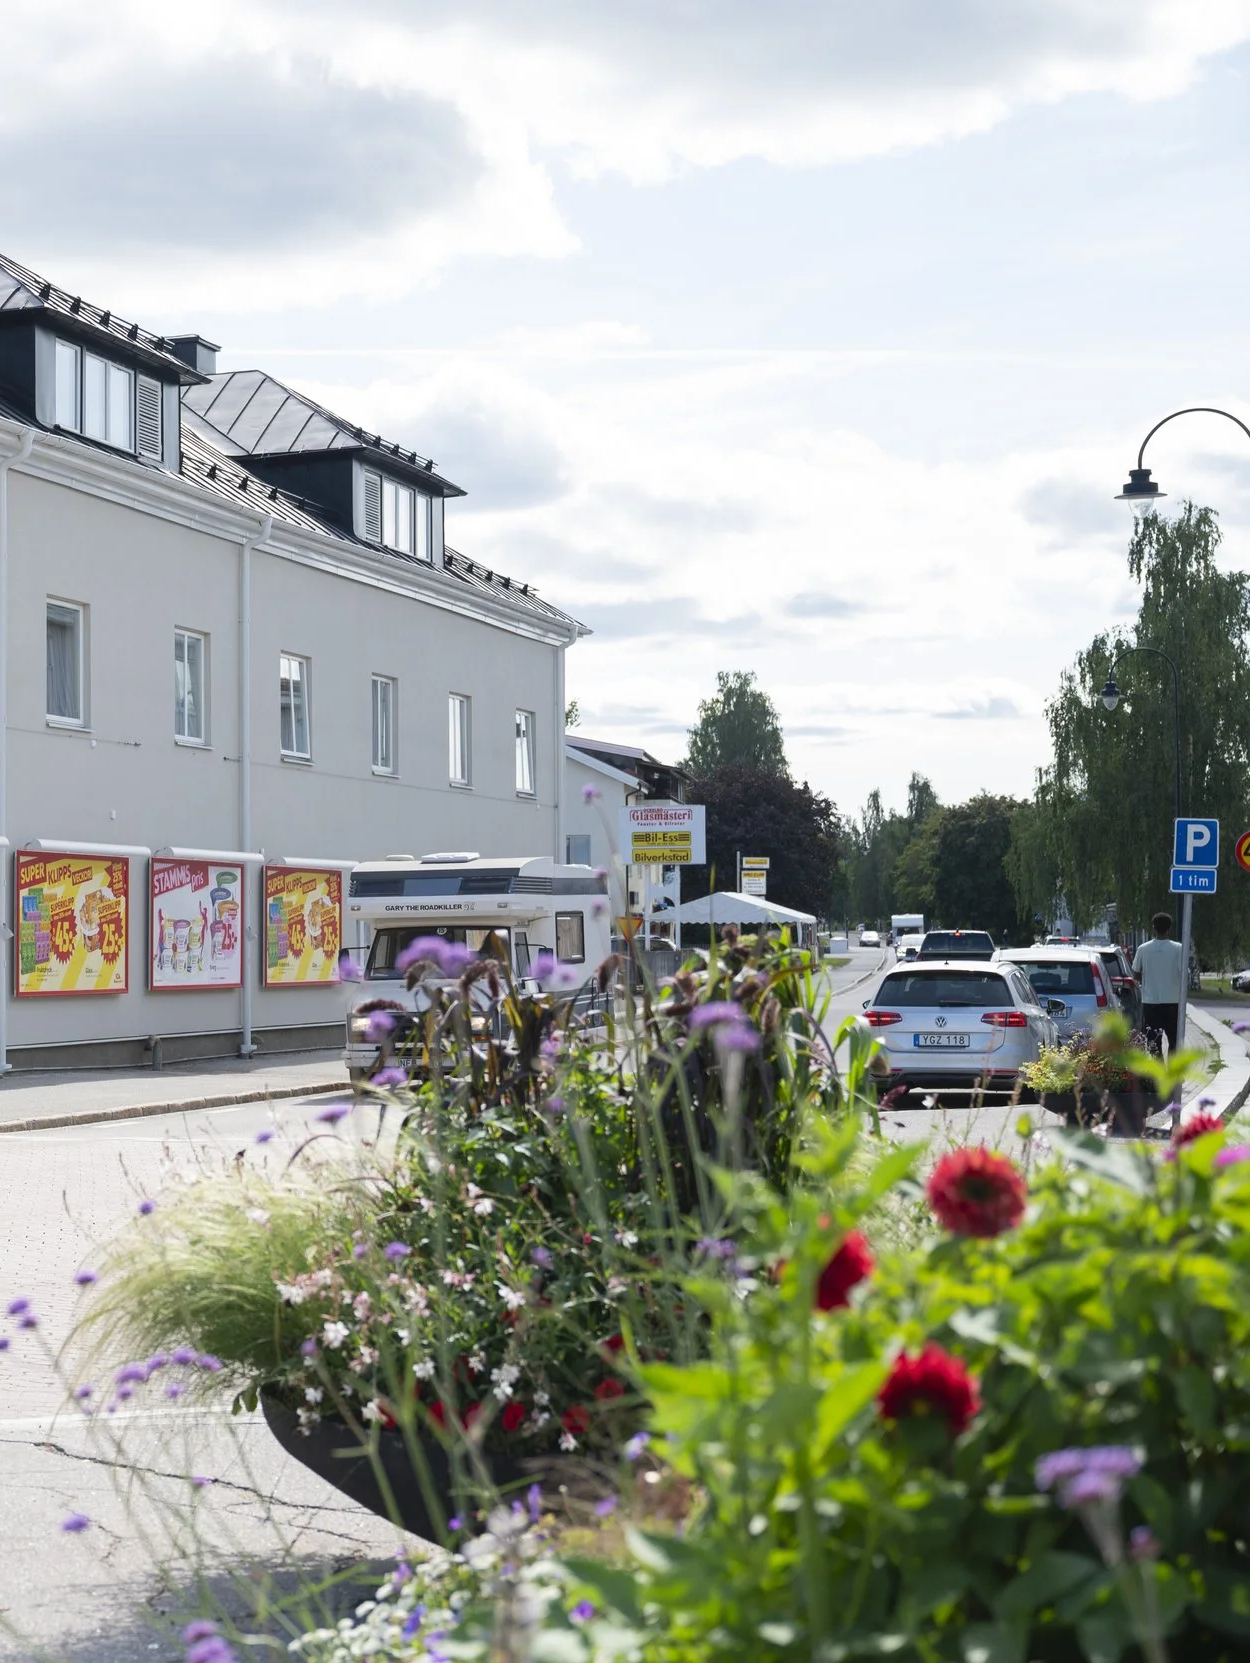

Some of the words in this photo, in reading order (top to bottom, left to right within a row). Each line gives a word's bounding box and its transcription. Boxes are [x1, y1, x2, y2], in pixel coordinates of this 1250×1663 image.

[632, 809, 691, 822] Glasmästeri
[645, 833, 678, 842] Bil-Ess
[1186, 824, 1211, 862] P
[635, 852, 689, 862] Bilverkstad
[20, 862, 45, 885] SUPER
[47, 864, 72, 885] KLIPPS
[154, 865, 191, 894] STAMMIS
[191, 870, 204, 892] pris
[1178, 874, 1183, 886] 1
[1188, 874, 1209, 886] tim
[923, 1036, 942, 1044] YGZ
[946, 1035, 965, 1045] 118
